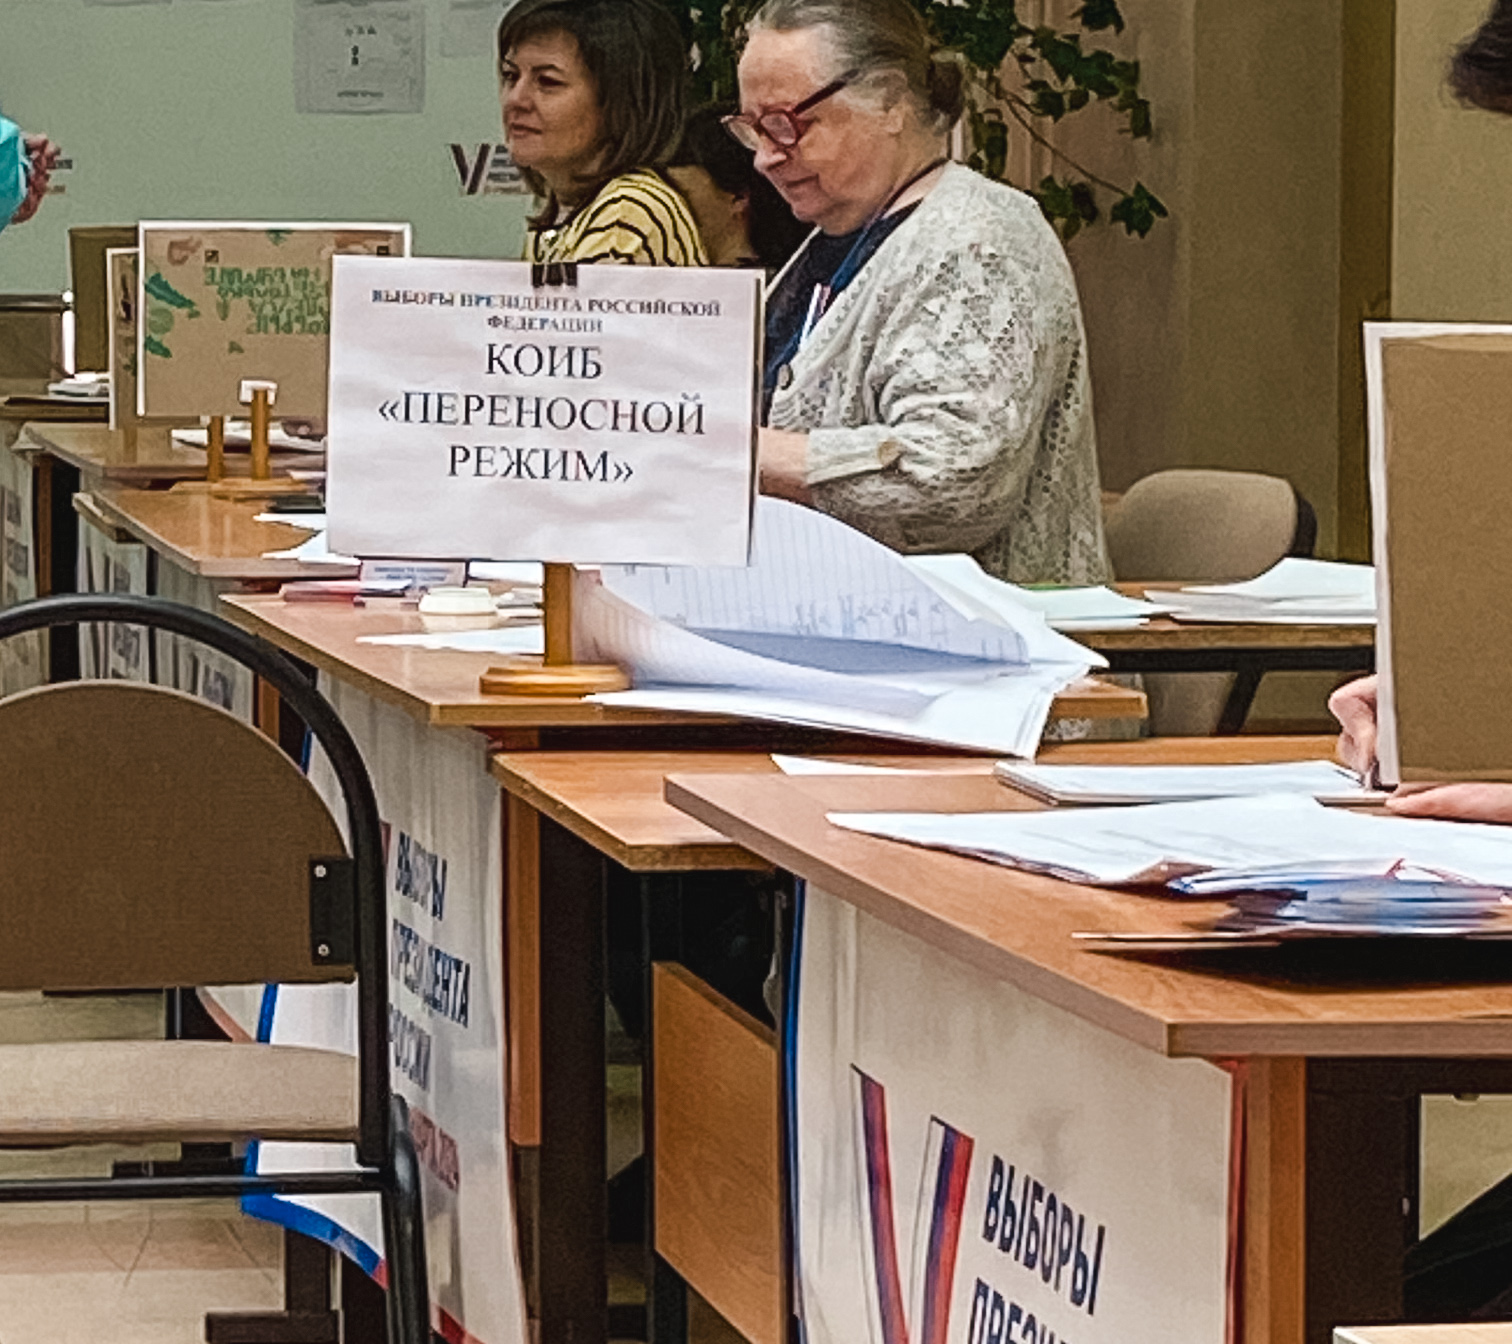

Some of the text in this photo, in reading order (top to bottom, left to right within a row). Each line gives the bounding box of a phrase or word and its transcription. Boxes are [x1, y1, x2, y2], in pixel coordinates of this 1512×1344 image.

[372, 289, 722, 316] ВЫБОРЫ ПРЕЗИДЕНТА РОССИЙСКОЙ
[488, 315, 603, 333] ФЕДЕРАЦИИ
[485, 342, 603, 379] КОИБ
[378, 391, 706, 435] «ПЕРЕНОСНОЙ
[448, 444, 634, 484] РЕЖИМ»
[982, 1154, 1106, 1316] ВЫБОРЫ
